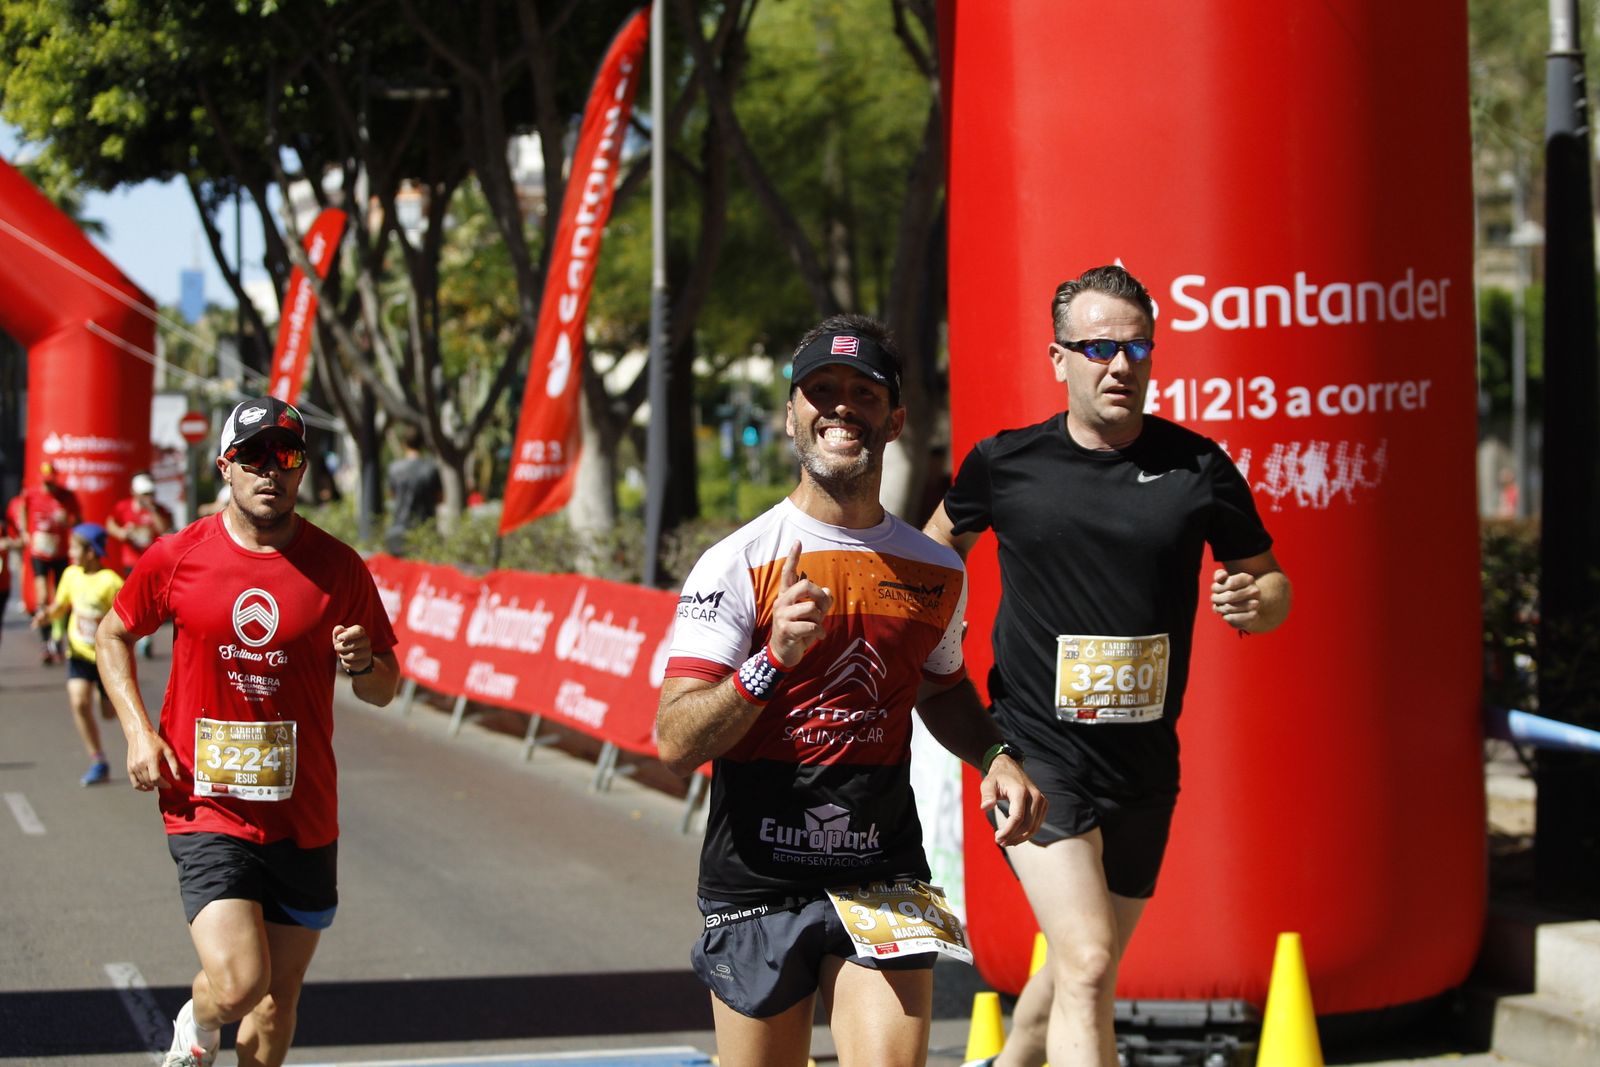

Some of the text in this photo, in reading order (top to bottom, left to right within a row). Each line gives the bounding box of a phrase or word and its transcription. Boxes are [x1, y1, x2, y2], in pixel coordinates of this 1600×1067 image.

[1171, 267, 1451, 332] Santander
[1286, 386, 1311, 419] a
[1318, 379, 1431, 416] correr
[691, 607, 717, 623] CAR
[219, 644, 263, 661] Salinas
[237, 673, 281, 687] CARRERA
[1070, 663, 1154, 692] 3260
[1083, 693, 1110, 706] DAVID
[1120, 692, 1150, 705] MOLINA
[206, 744, 281, 772] 3224
[234, 772, 258, 784] JESUS
[759, 817, 881, 855] Europack
[721, 904, 769, 922] Kalenji
[849, 900, 945, 931] 3194
[891, 925, 937, 940] MACHINE
